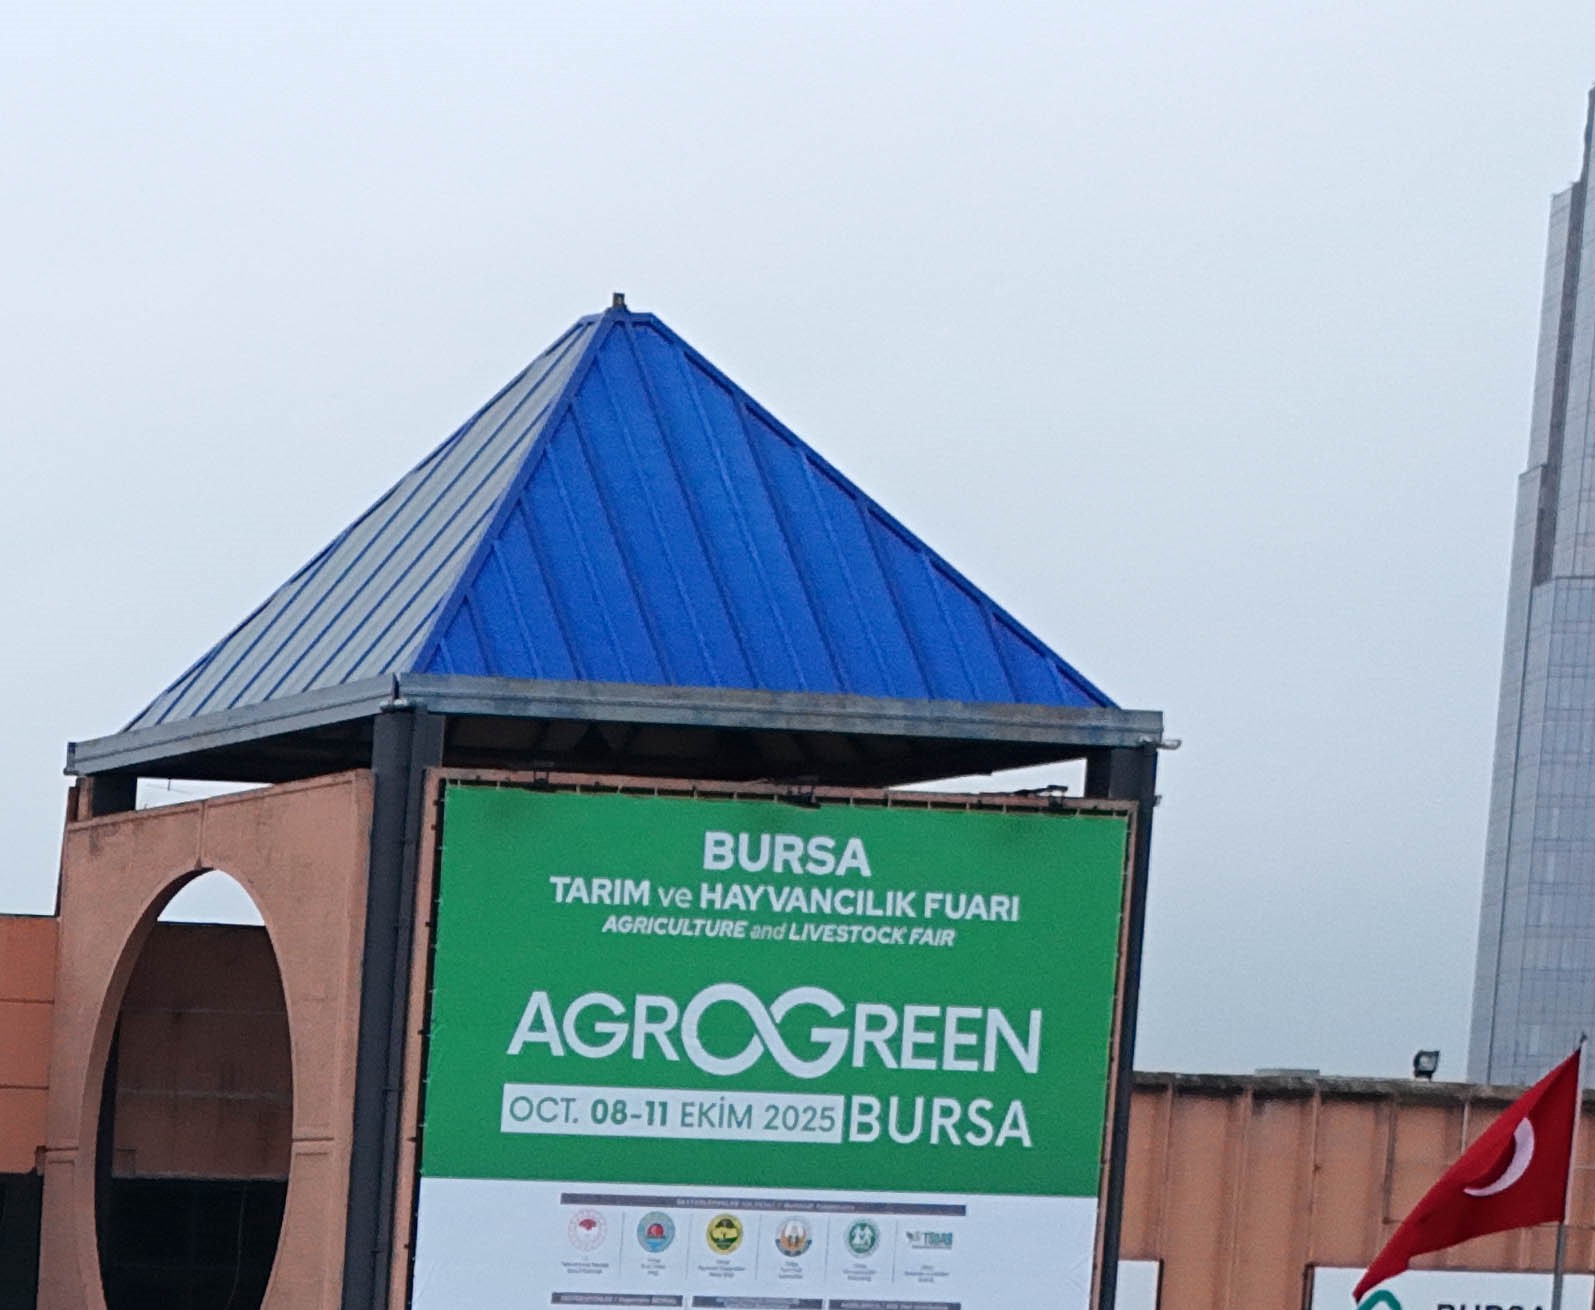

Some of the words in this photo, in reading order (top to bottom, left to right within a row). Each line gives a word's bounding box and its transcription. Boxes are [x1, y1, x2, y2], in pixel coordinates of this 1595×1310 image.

[703, 830, 872, 877] BURSA
[549, 875, 650, 906] TARIM
[659, 889, 692, 908] ve
[699, 882, 917, 918] HAYVANCILIK
[924, 892, 1020, 921] FUARI
[602, 914, 746, 938] AGRICULTURE
[750, 922, 786, 941] and
[789, 922, 907, 945] LIVESTOCK
[909, 927, 955, 947] FAIR
[507, 982, 1042, 1079] AGROGREEN
[509, 1094, 578, 1124] OCT.
[589, 1099, 669, 1128] 08-11
[680, 1094, 752, 1130] EKİM
[762, 1104, 836, 1133] 2025
[847, 1094, 1032, 1148] BURSA
